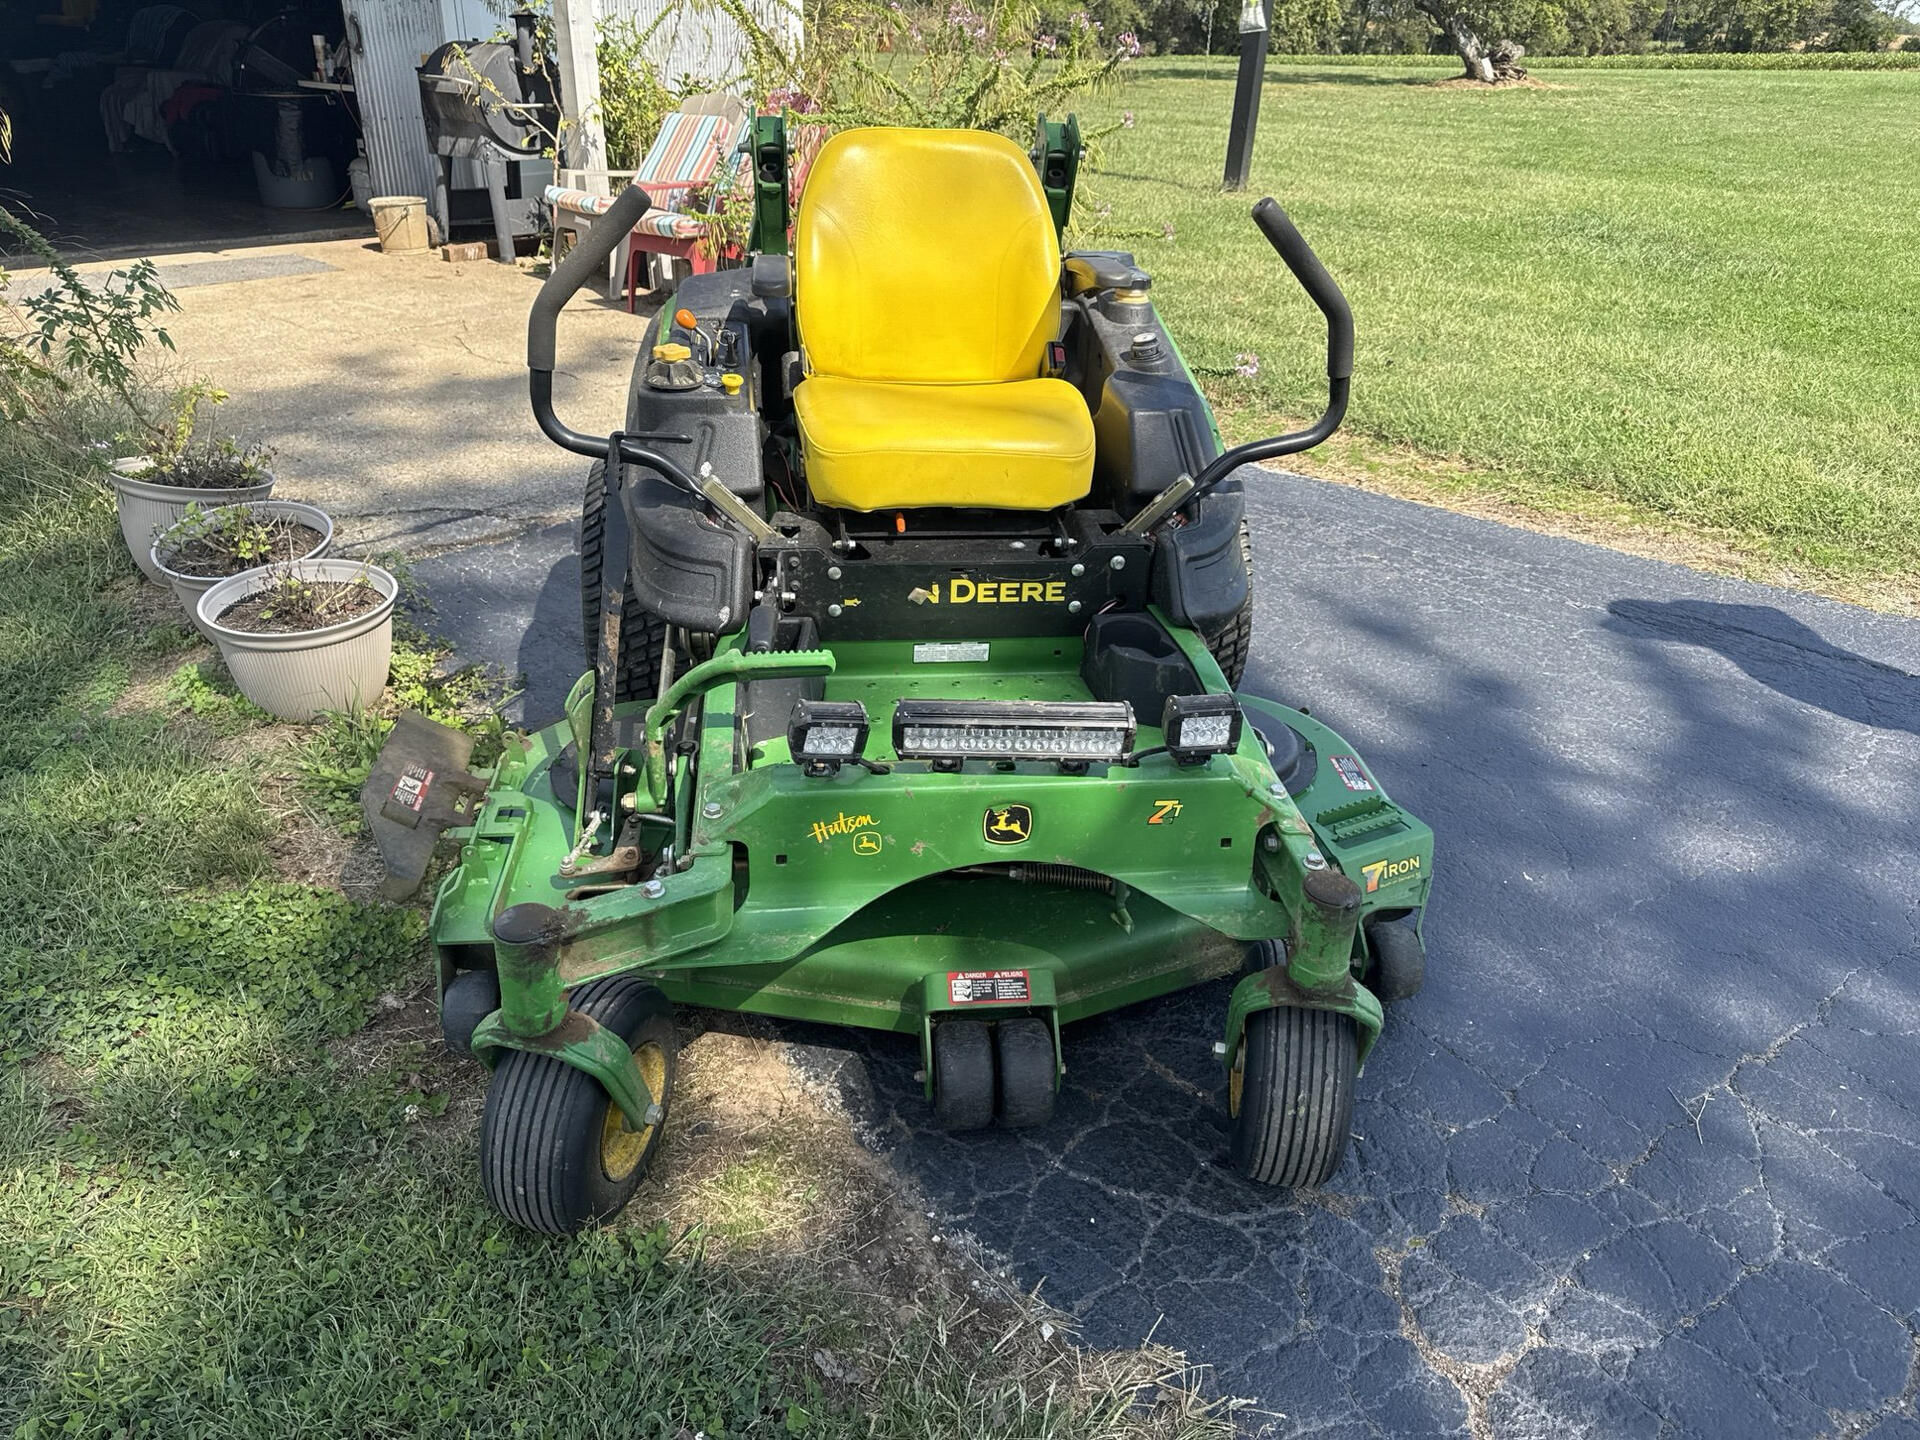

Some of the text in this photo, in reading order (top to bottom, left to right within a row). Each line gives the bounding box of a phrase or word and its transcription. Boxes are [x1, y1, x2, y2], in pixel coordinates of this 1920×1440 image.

[950, 578, 1067, 604] DEERE
[807, 812, 881, 843] Hutson
[1361, 859, 1388, 893] 7
[1383, 855, 1420, 879] IRON
[1000, 970, 1024, 978] PELIGRO
